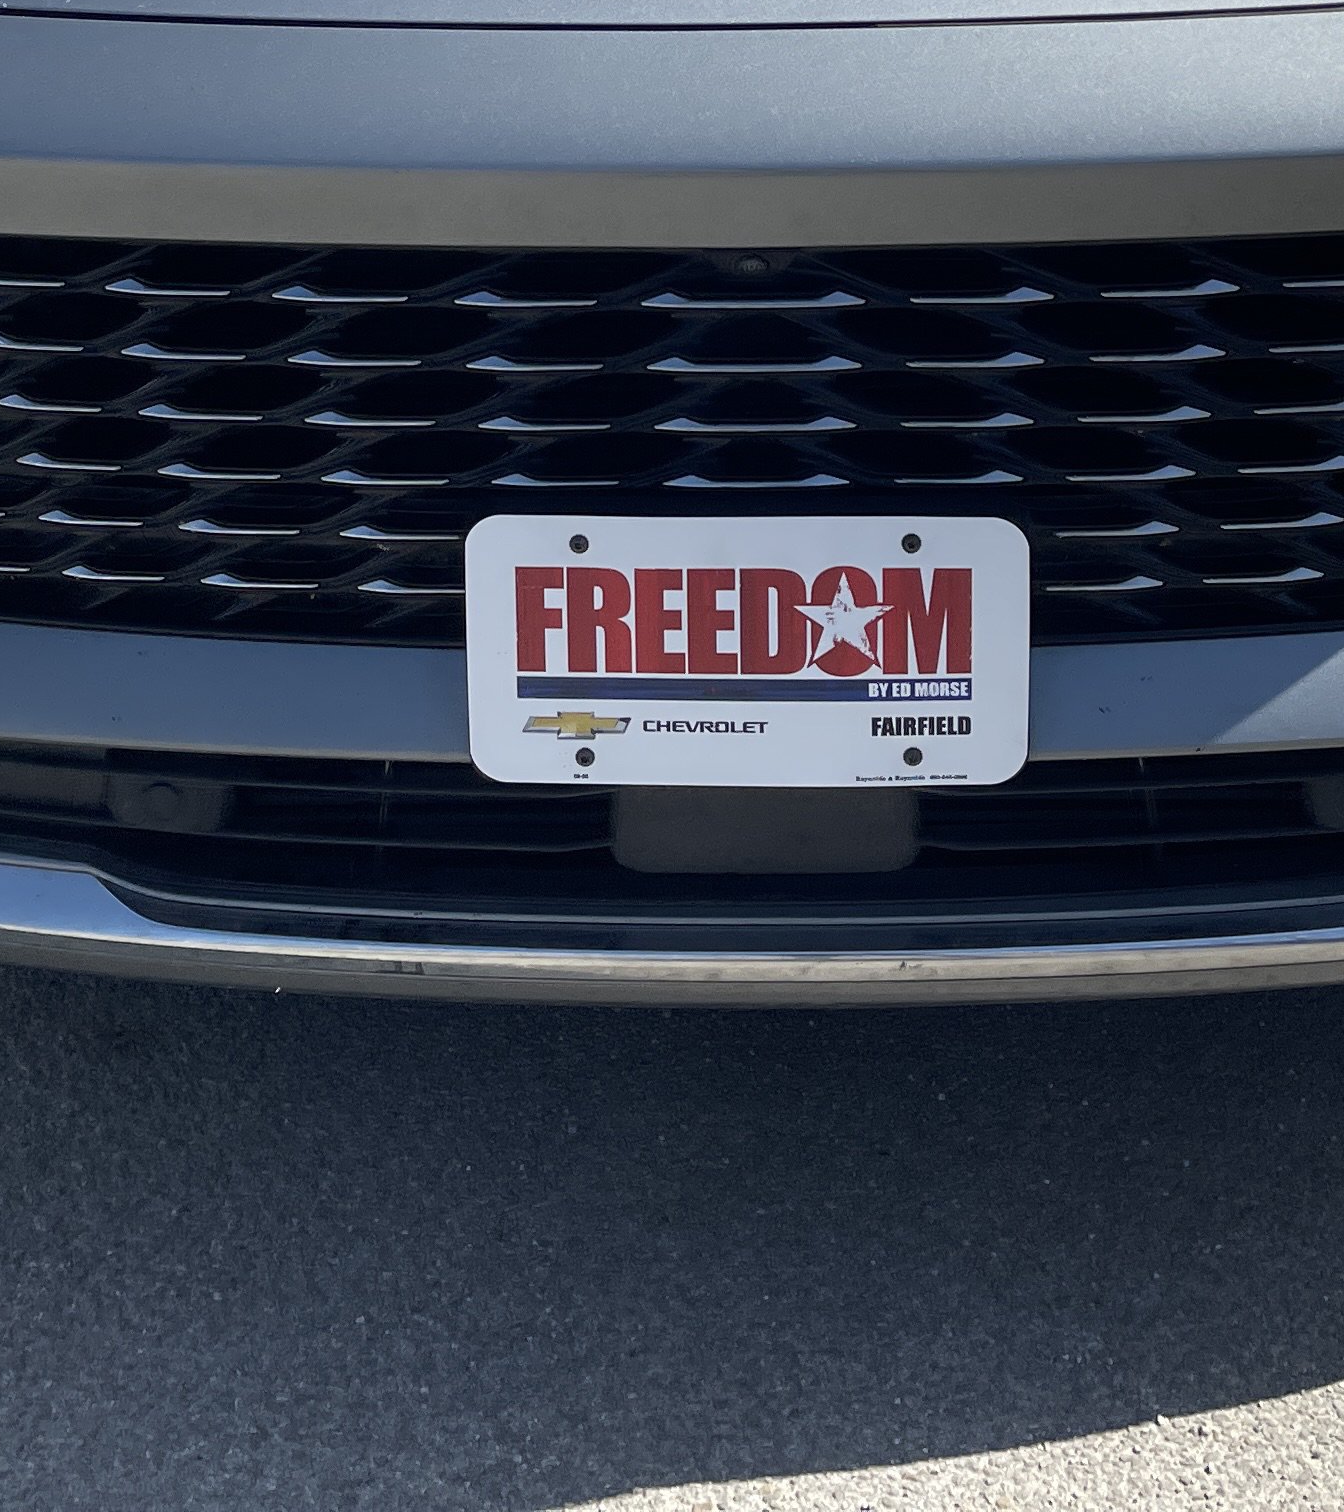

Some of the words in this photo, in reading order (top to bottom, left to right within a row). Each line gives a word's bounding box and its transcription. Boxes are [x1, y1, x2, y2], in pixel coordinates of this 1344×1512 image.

[514, 565, 973, 678] FREEDOM
[868, 682, 889, 698] BY
[891, 682, 911, 698] ED
[914, 681, 969, 698] MORSE
[642, 720, 769, 734] CHEVROLET
[871, 716, 972, 737] FAIRFIELD
